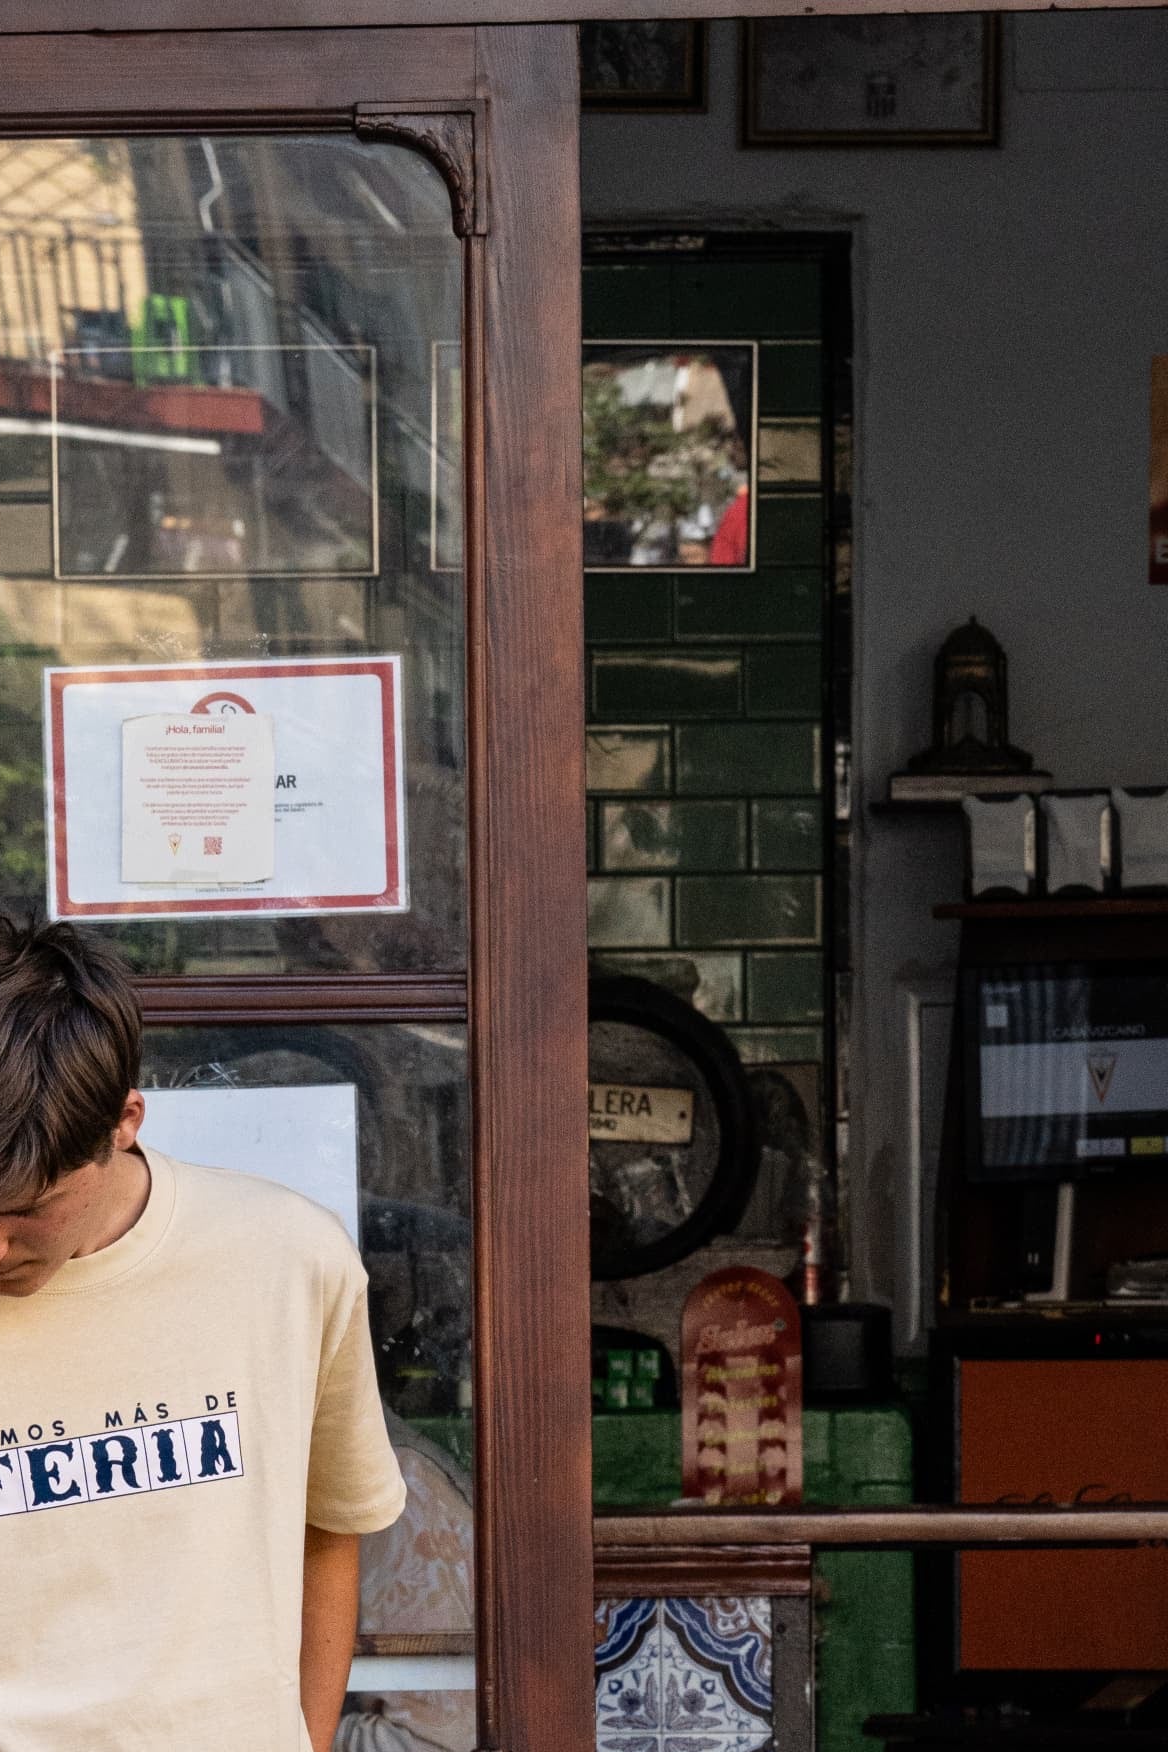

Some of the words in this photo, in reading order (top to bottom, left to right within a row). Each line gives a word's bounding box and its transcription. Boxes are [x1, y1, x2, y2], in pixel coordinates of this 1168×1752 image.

[193, 723, 225, 734] familia!
[104, 1402, 169, 1428] MÁS
[204, 1390, 238, 1411] DE
